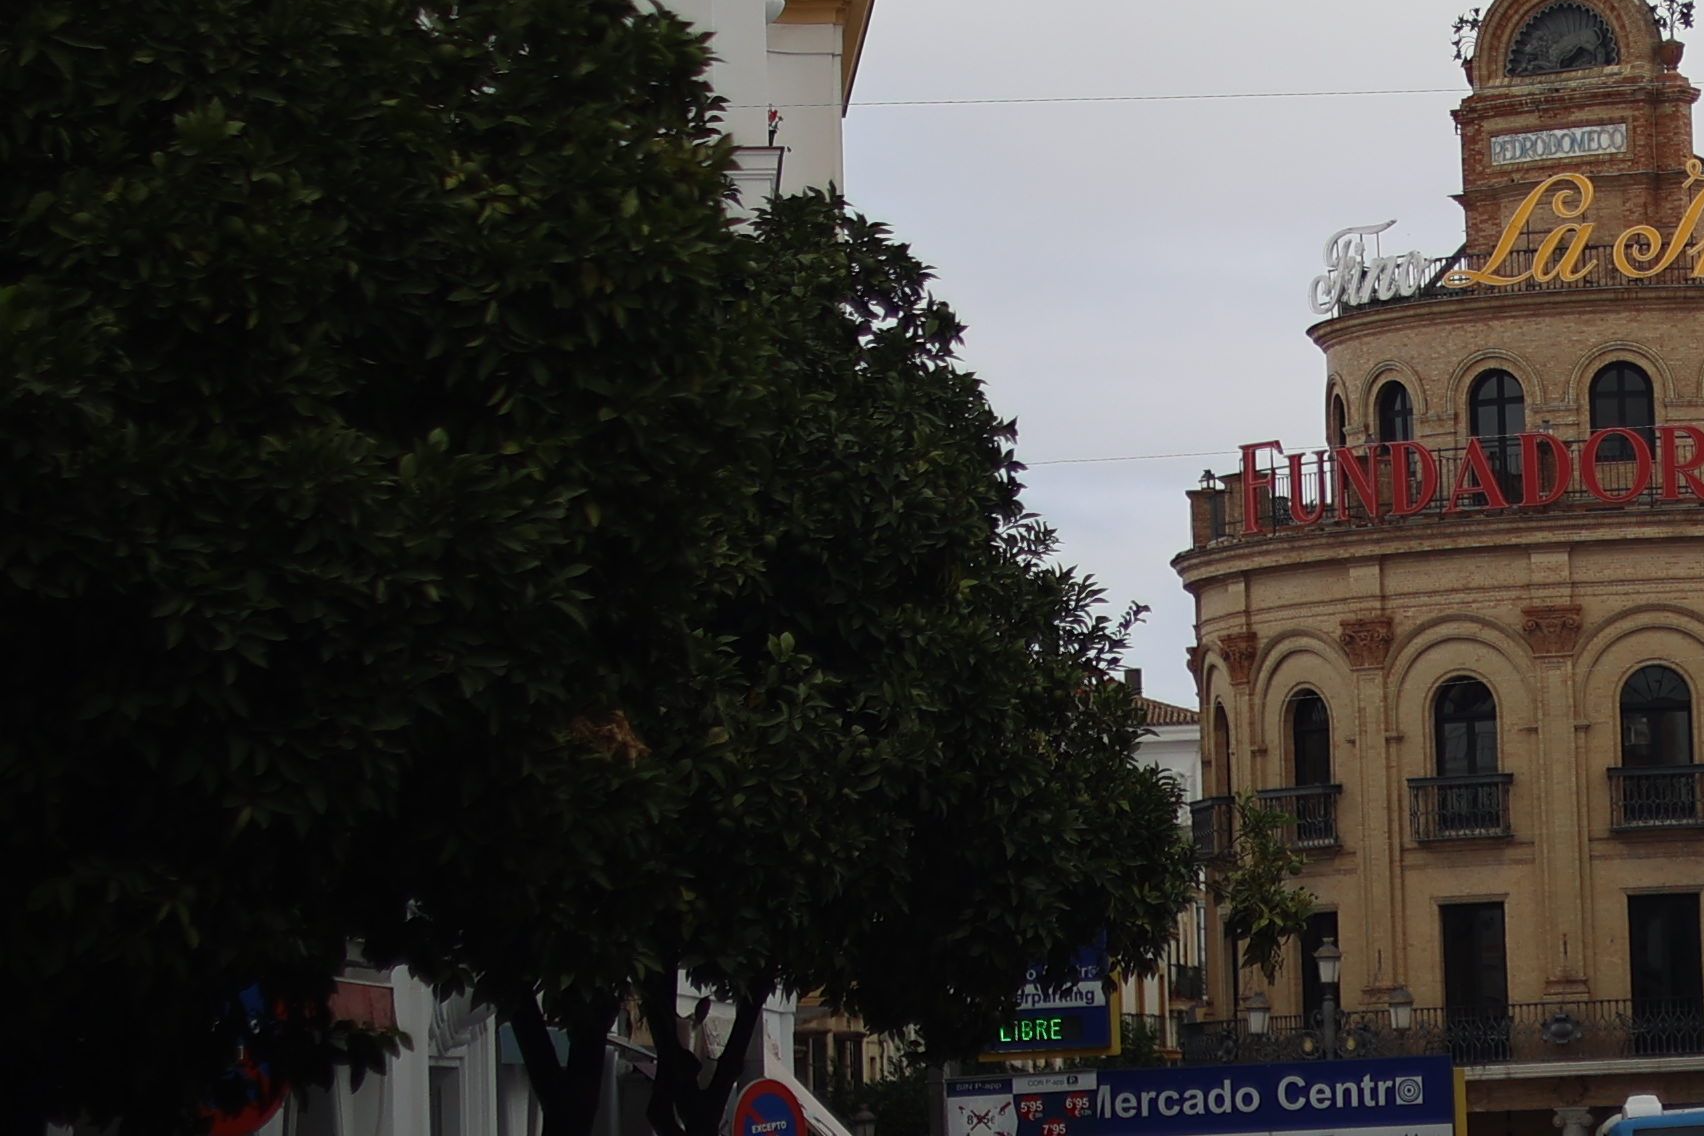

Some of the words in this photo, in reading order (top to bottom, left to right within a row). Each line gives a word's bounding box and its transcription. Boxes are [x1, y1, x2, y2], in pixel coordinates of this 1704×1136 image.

[1308, 219, 1434, 314] Fino
[1443, 173, 1598, 288] La
[999, 1019, 1063, 1042] LIBRE
[752, 1120, 787, 1134] EXCEPTO
